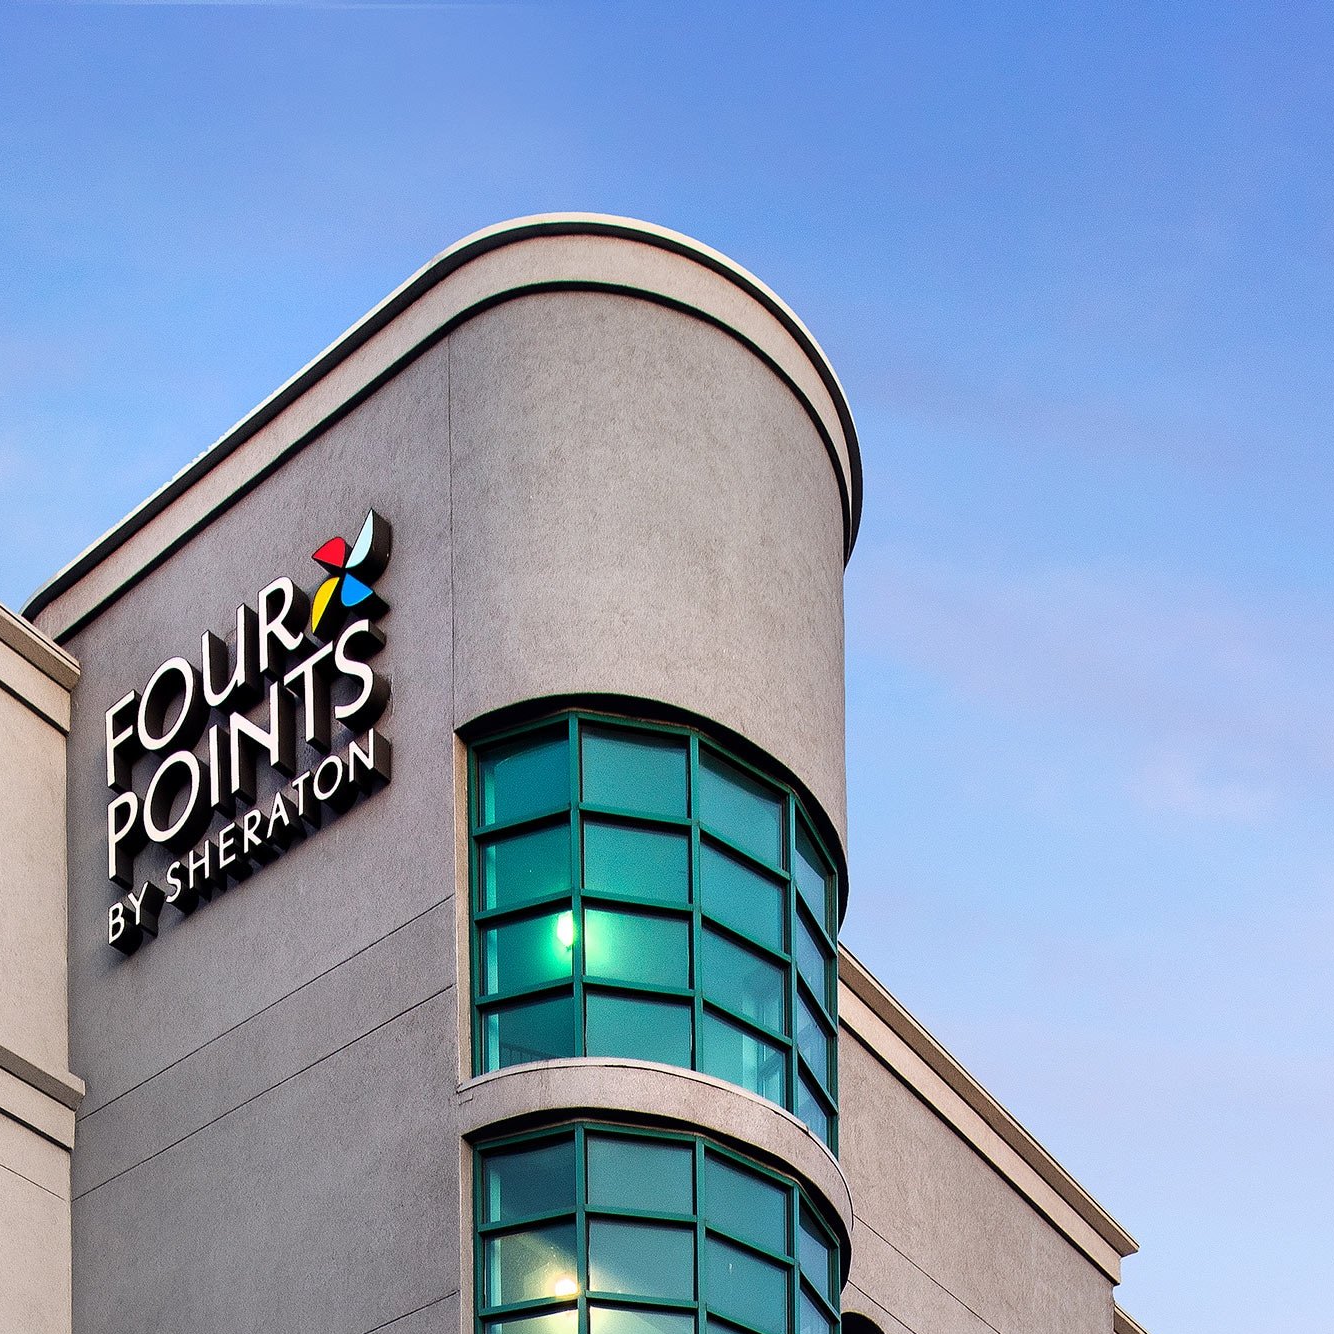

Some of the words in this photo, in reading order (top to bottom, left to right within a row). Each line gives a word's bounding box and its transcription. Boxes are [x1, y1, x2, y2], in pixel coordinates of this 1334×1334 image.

[106, 576, 304, 788] FOUR
[107, 619, 375, 881] POINTS
[108, 882, 150, 945] BY
[165, 729, 375, 904] SHERATON
